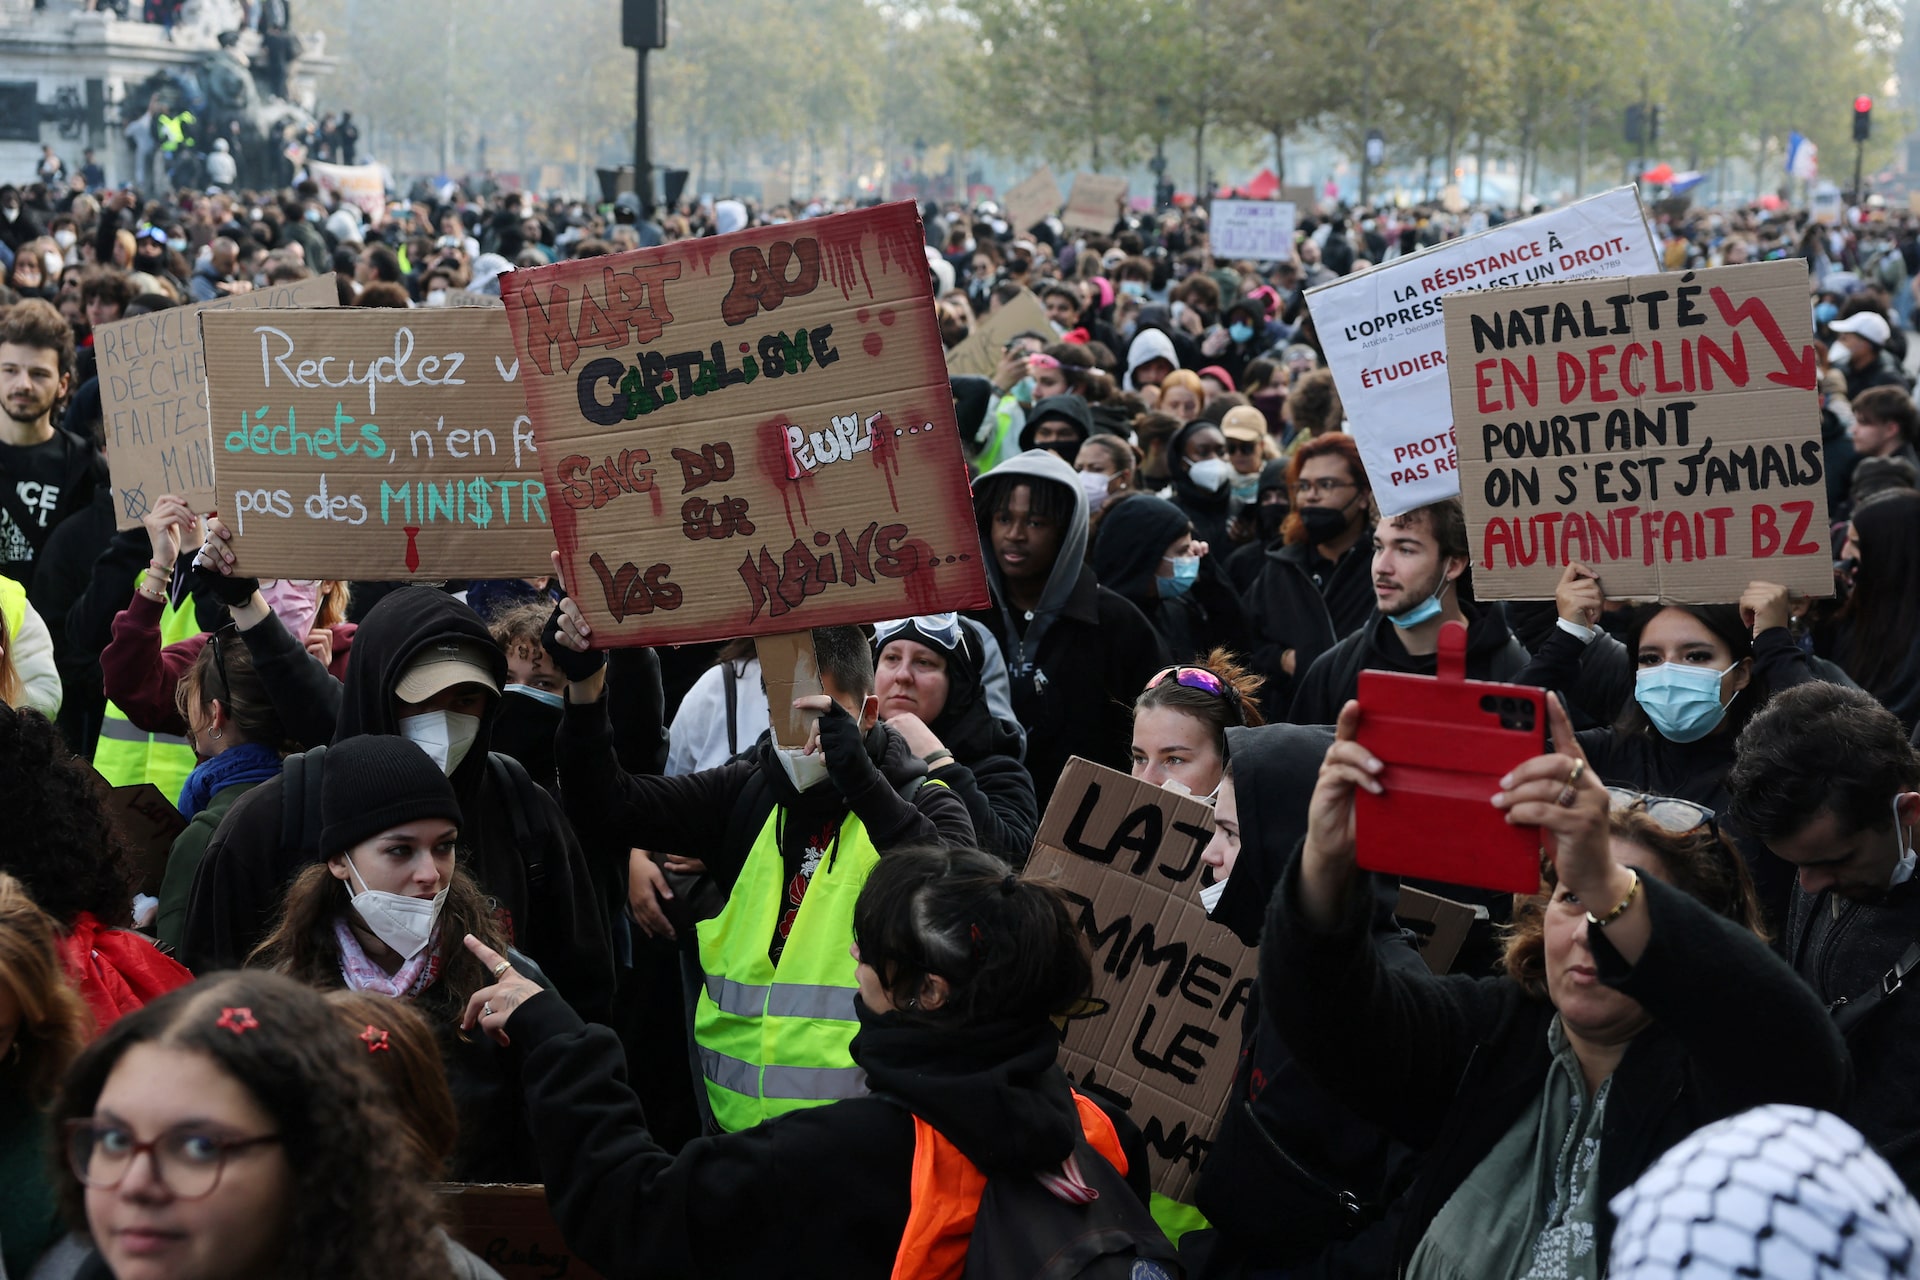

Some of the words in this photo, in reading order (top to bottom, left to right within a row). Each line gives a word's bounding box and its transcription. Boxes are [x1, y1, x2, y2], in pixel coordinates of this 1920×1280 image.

[721, 237, 820, 326] AU
[1393, 285, 1418, 304] LA
[1421, 241, 1543, 294] RÉSISTANCE
[1547, 231, 1564, 252] À
[1525, 262, 1555, 282] UN
[1559, 237, 1630, 271] DROIT.
[103, 301, 232, 367] RECYCL
[1362, 337, 1388, 349] Article
[1388, 333, 1395, 342] 2
[1600, 260, 1622, 271] 1789
[1470, 271, 1708, 354] NATALITÉ
[253, 325, 466, 415] Recyclez
[1361, 350, 1446, 389] ÉTUDIER
[1475, 354, 1541, 414] EN
[1559, 331, 1750, 404] DECLIN
[224, 402, 396, 464] déchets,
[410, 415, 496, 459] n'en
[235, 489, 294, 537] pas
[304, 473, 368, 525] des
[557, 448, 664, 510] SANG
[671, 442, 735, 494] DU
[1390, 463, 1430, 487] PAS
[1484, 467, 1541, 508] ON
[1555, 456, 1666, 504] S'EST
[681, 495, 756, 541] SUR
[1751, 500, 1820, 559] BZ
[1132, 1004, 1219, 1085] LE
